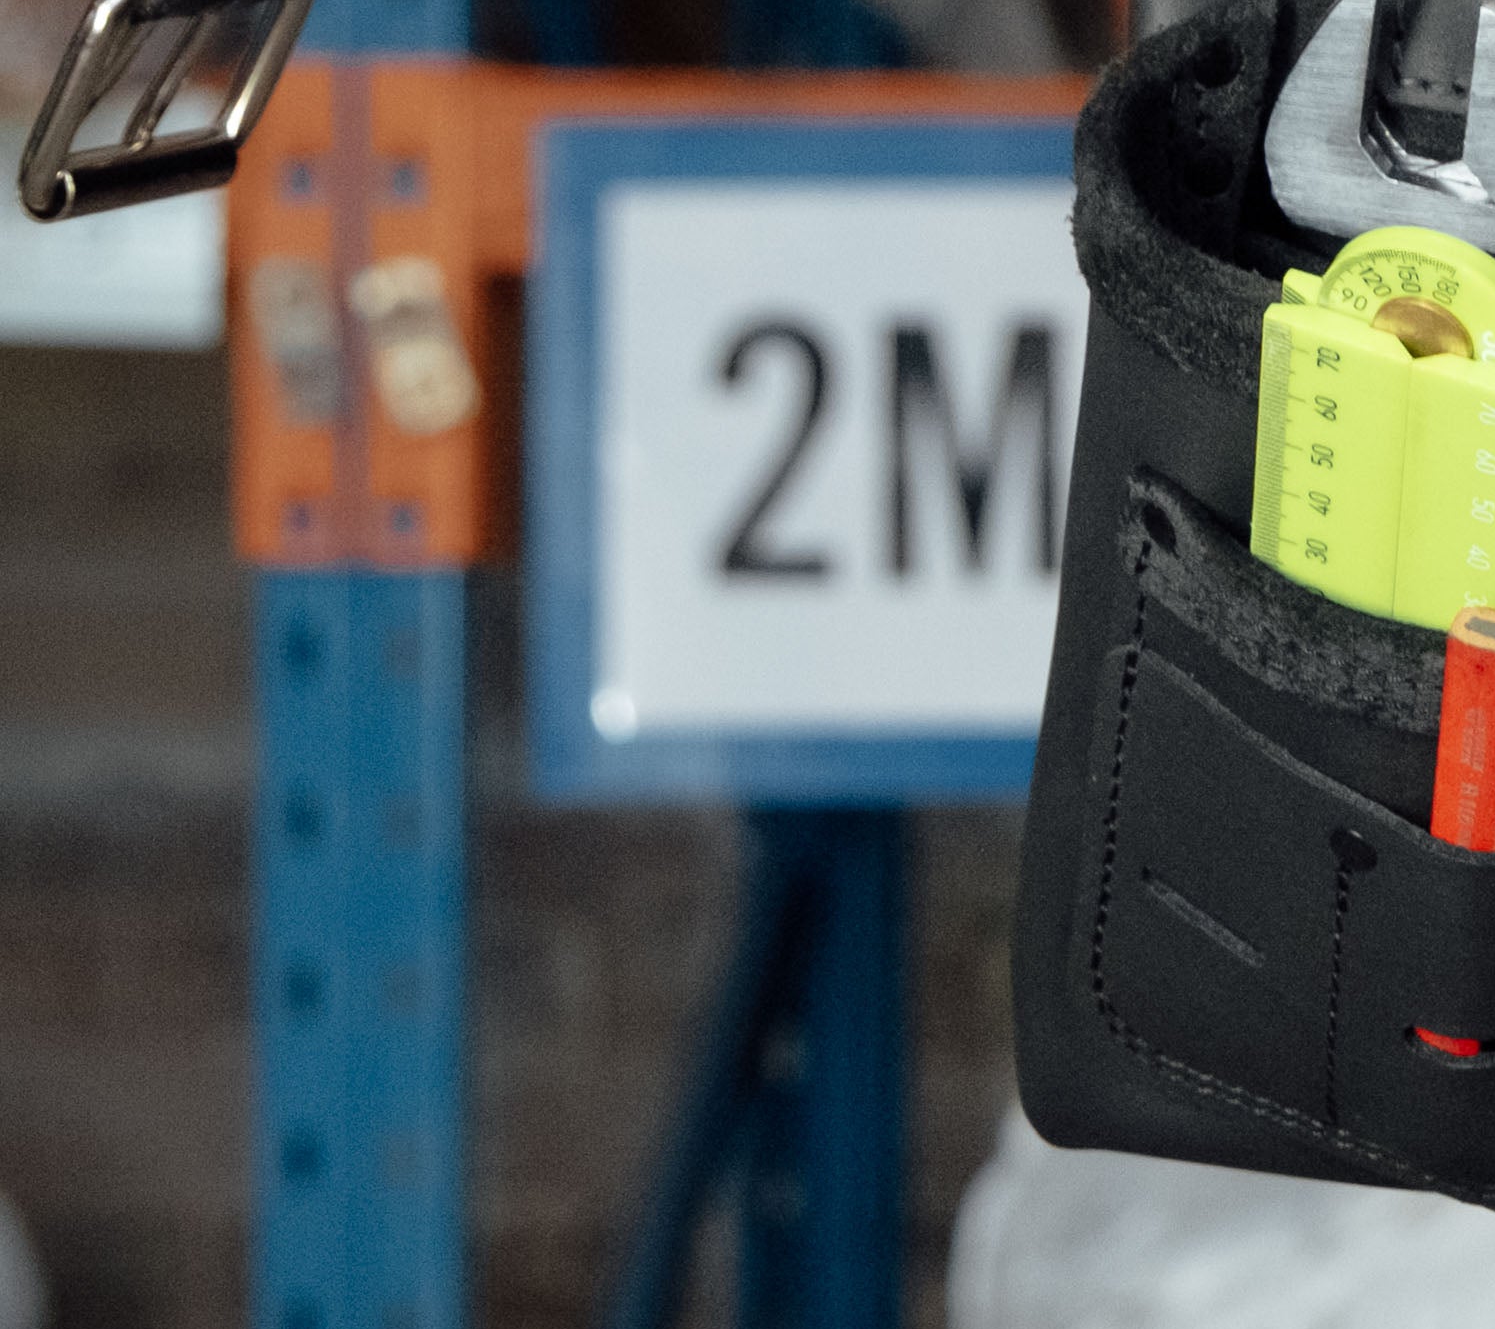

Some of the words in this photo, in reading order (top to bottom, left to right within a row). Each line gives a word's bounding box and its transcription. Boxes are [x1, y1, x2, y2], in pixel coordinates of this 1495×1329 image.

[1342, 288, 1367, 312] 90
[1359, 267, 1392, 297] 120
[1397, 265, 1421, 294] 150
[1432, 276, 1460, 305] 180
[1316, 346, 1341, 372] 70
[1314, 395, 1338, 421] 60
[1311, 443, 1334, 469] 50
[1308, 490, 1331, 516] 40
[1471, 496, 1495, 524] 50
[1305, 538, 1328, 564] 30
[1466, 543, 1491, 571] 40
